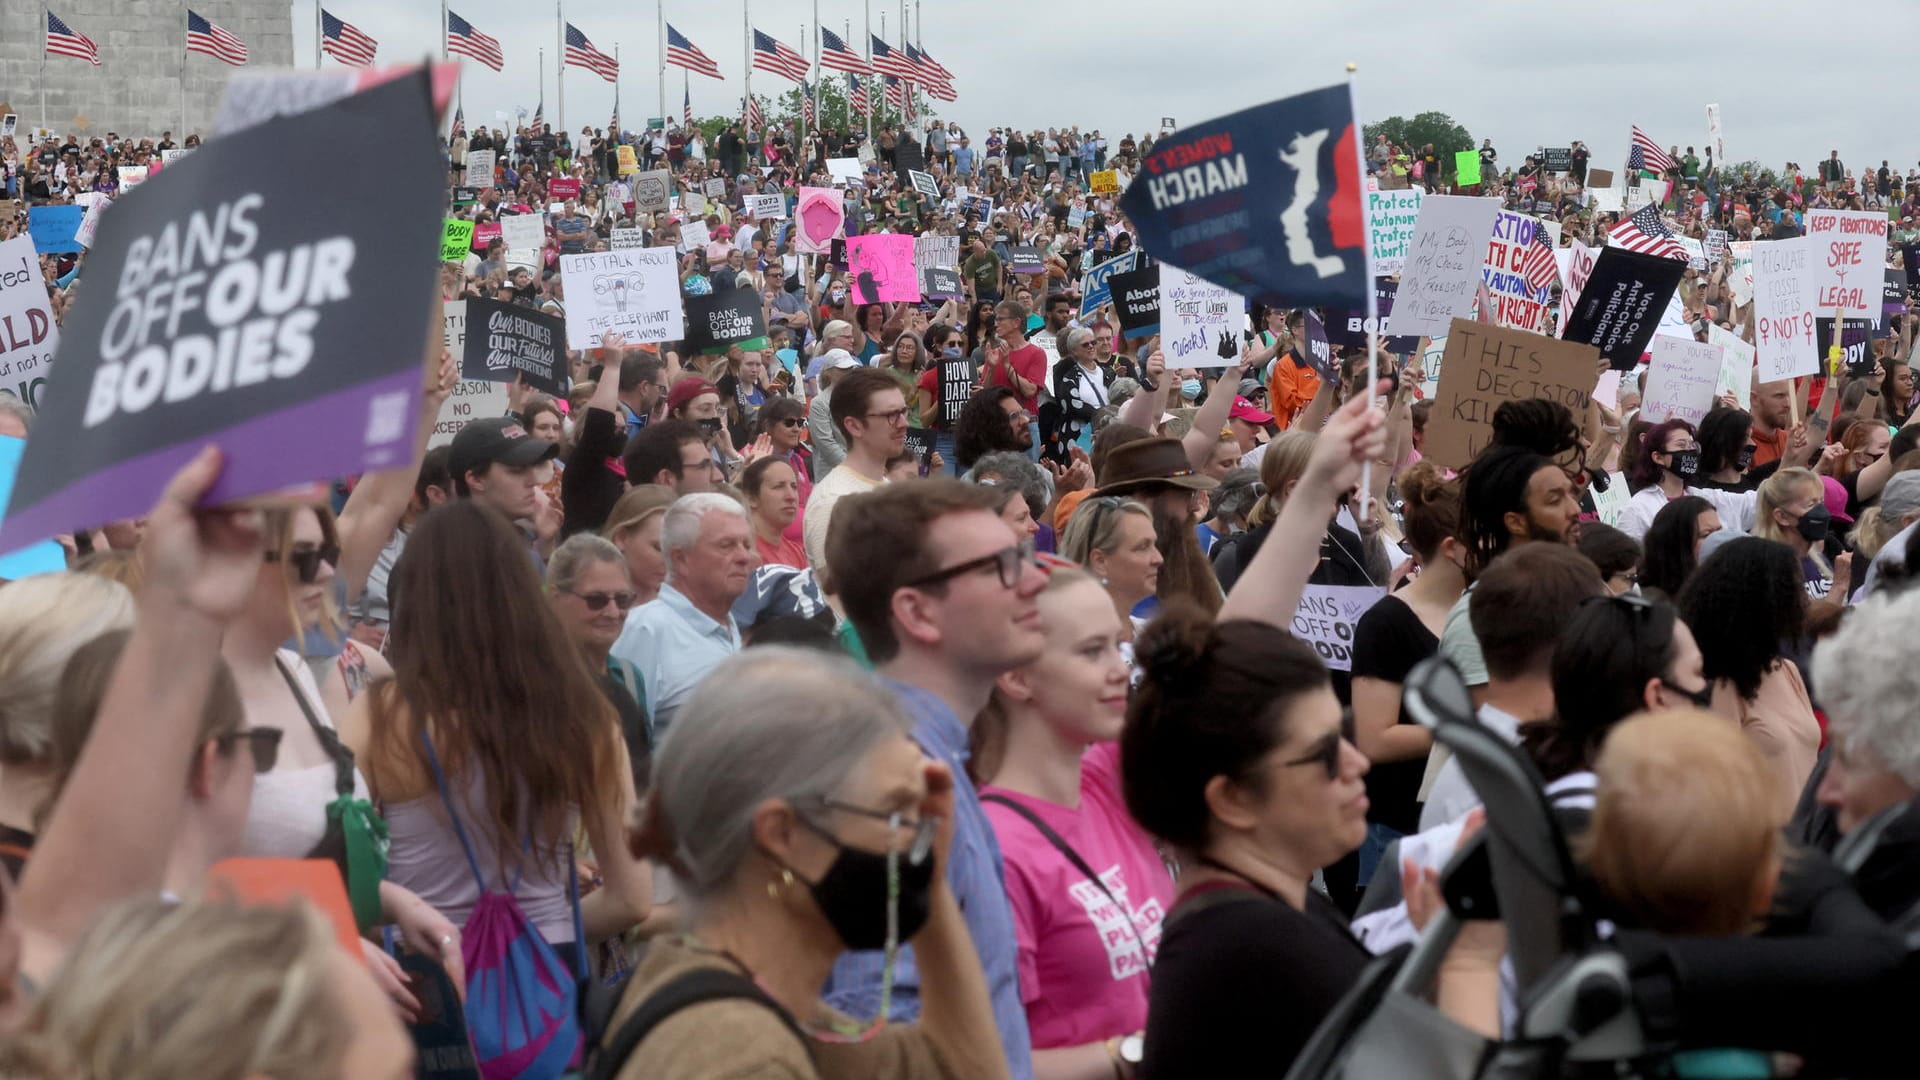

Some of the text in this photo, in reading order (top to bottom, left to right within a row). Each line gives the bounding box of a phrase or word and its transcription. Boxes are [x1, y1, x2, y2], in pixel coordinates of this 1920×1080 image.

[758, 197, 779, 206] 1973
[1369, 193, 1422, 211] Protect
[448, 225, 470, 237] BODY
[1371, 213, 1418, 228] Autonom
[1811, 215, 1886, 237] KEEP ABORTIONS
[117, 193, 263, 300] BANS
[1827, 241, 1862, 268] SAFE
[566, 252, 670, 274] LET'S TALK ABOUT
[1574, 249, 1592, 275] NO
[1762, 250, 1806, 274] REGULATE
[1768, 277, 1800, 297] FOSSIL
[1893, 281, 1899, 289] is
[101, 236, 356, 360] OFF OUR
[1174, 300, 1201, 314] PROTECT
[1819, 287, 1867, 310] LEGAL
[588, 310, 670, 330] THE ELEPHANT
[709, 308, 739, 321] BANS
[710, 316, 754, 331] OFF OUR
[1592, 282, 1627, 344] Politicians
[1604, 280, 1643, 352] Anti-Choice
[1622, 292, 1655, 344] Vote Out
[488, 311, 551, 345] Our BODIES
[637, 327, 667, 340] WOMB
[712, 326, 752, 340] BODIES
[1774, 316, 1799, 339] NOT
[486, 350, 511, 371] Our
[489, 334, 555, 366] OUR Futures
[1311, 339, 1330, 365] BODY
[1459, 330, 1543, 374] THIS
[18, 352, 39, 374] not
[83, 309, 320, 428] BODIES
[945, 361, 970, 382] HOW
[1774, 355, 1797, 376] BODY
[945, 381, 973, 401] DARE
[1476, 368, 1590, 409] DECISION
[453, 403, 471, 416] NO
[945, 401, 968, 421] THE
[432, 420, 466, 435] XCEP
[1293, 615, 1332, 638] OFF
